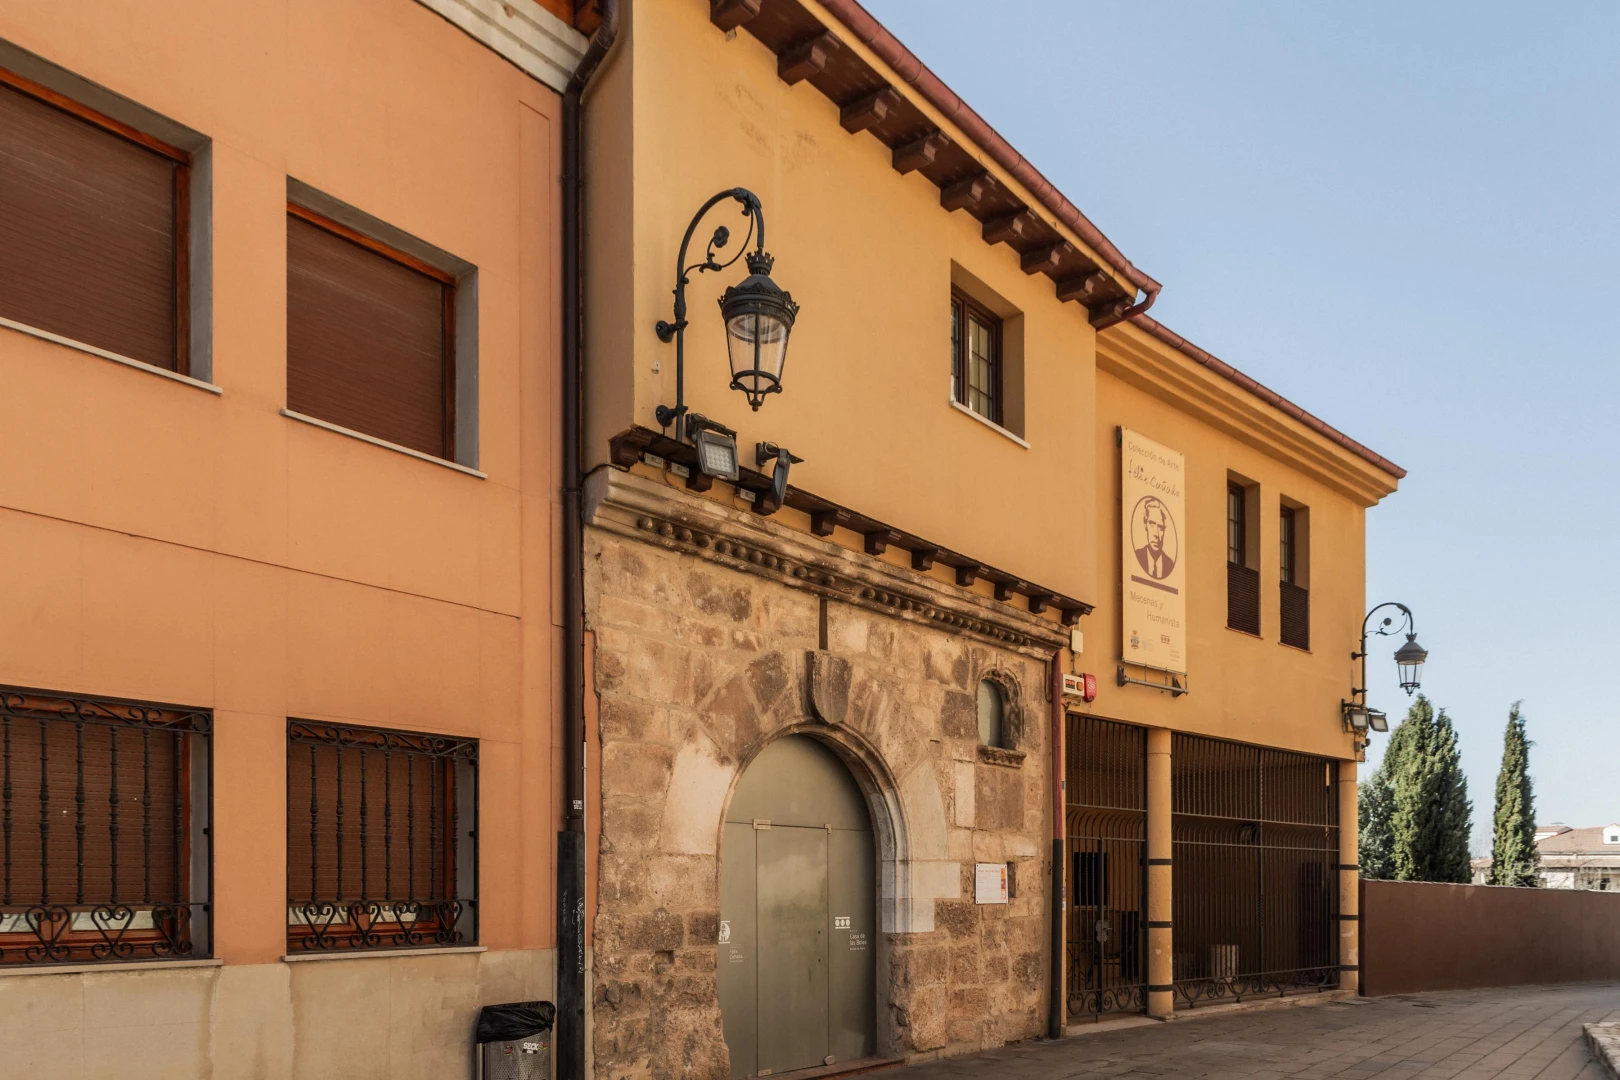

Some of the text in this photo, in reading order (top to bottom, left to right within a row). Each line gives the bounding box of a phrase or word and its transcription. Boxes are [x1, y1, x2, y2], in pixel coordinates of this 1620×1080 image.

[1128, 441, 1180, 471] Colección de Arte
[1130, 591, 1164, 611] Mecenas y
[1146, 611, 1180, 628] Humanista
